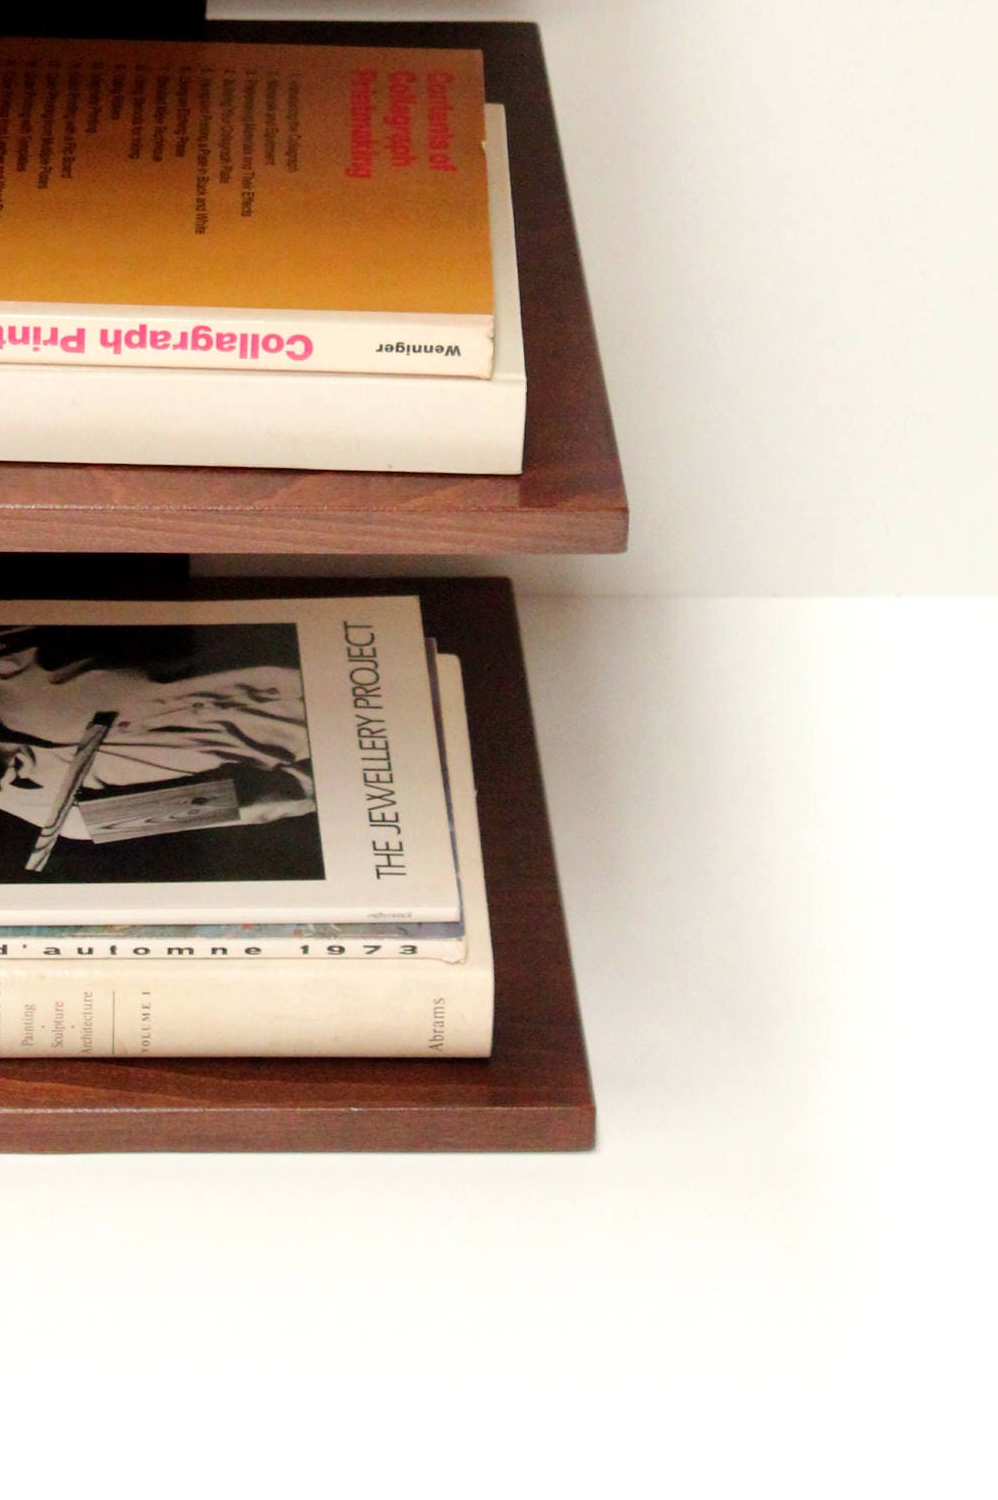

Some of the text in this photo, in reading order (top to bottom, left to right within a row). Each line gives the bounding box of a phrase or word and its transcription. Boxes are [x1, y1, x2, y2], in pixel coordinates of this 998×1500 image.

[345, 68, 378, 178] Printmaking
[384, 70, 417, 168] Collagraph
[426, 70, 457, 172] Contents of
[38, 167, 50, 188] Plates
[196, 176, 208, 195] Black
[195, 213, 207, 234] White
[196, 197, 207, 210] and
[241, 192, 253, 216] Effects
[99, 323, 314, 362] Collagraph
[375, 343, 462, 357] Wenniger
[343, 620, 383, 709] PROJECT
[355, 714, 401, 834] JEWELLERY
[372, 841, 407, 879] THE
[300, 944, 419, 956] 1973
[20, 1003, 36, 1046] Painting
[51, 1001, 64, 1048] Sculpture
[80, 991, 93, 1053] Architecture
[142, 1003, 151, 1052] VOLUME
[428, 997, 445, 1052] Abrams
